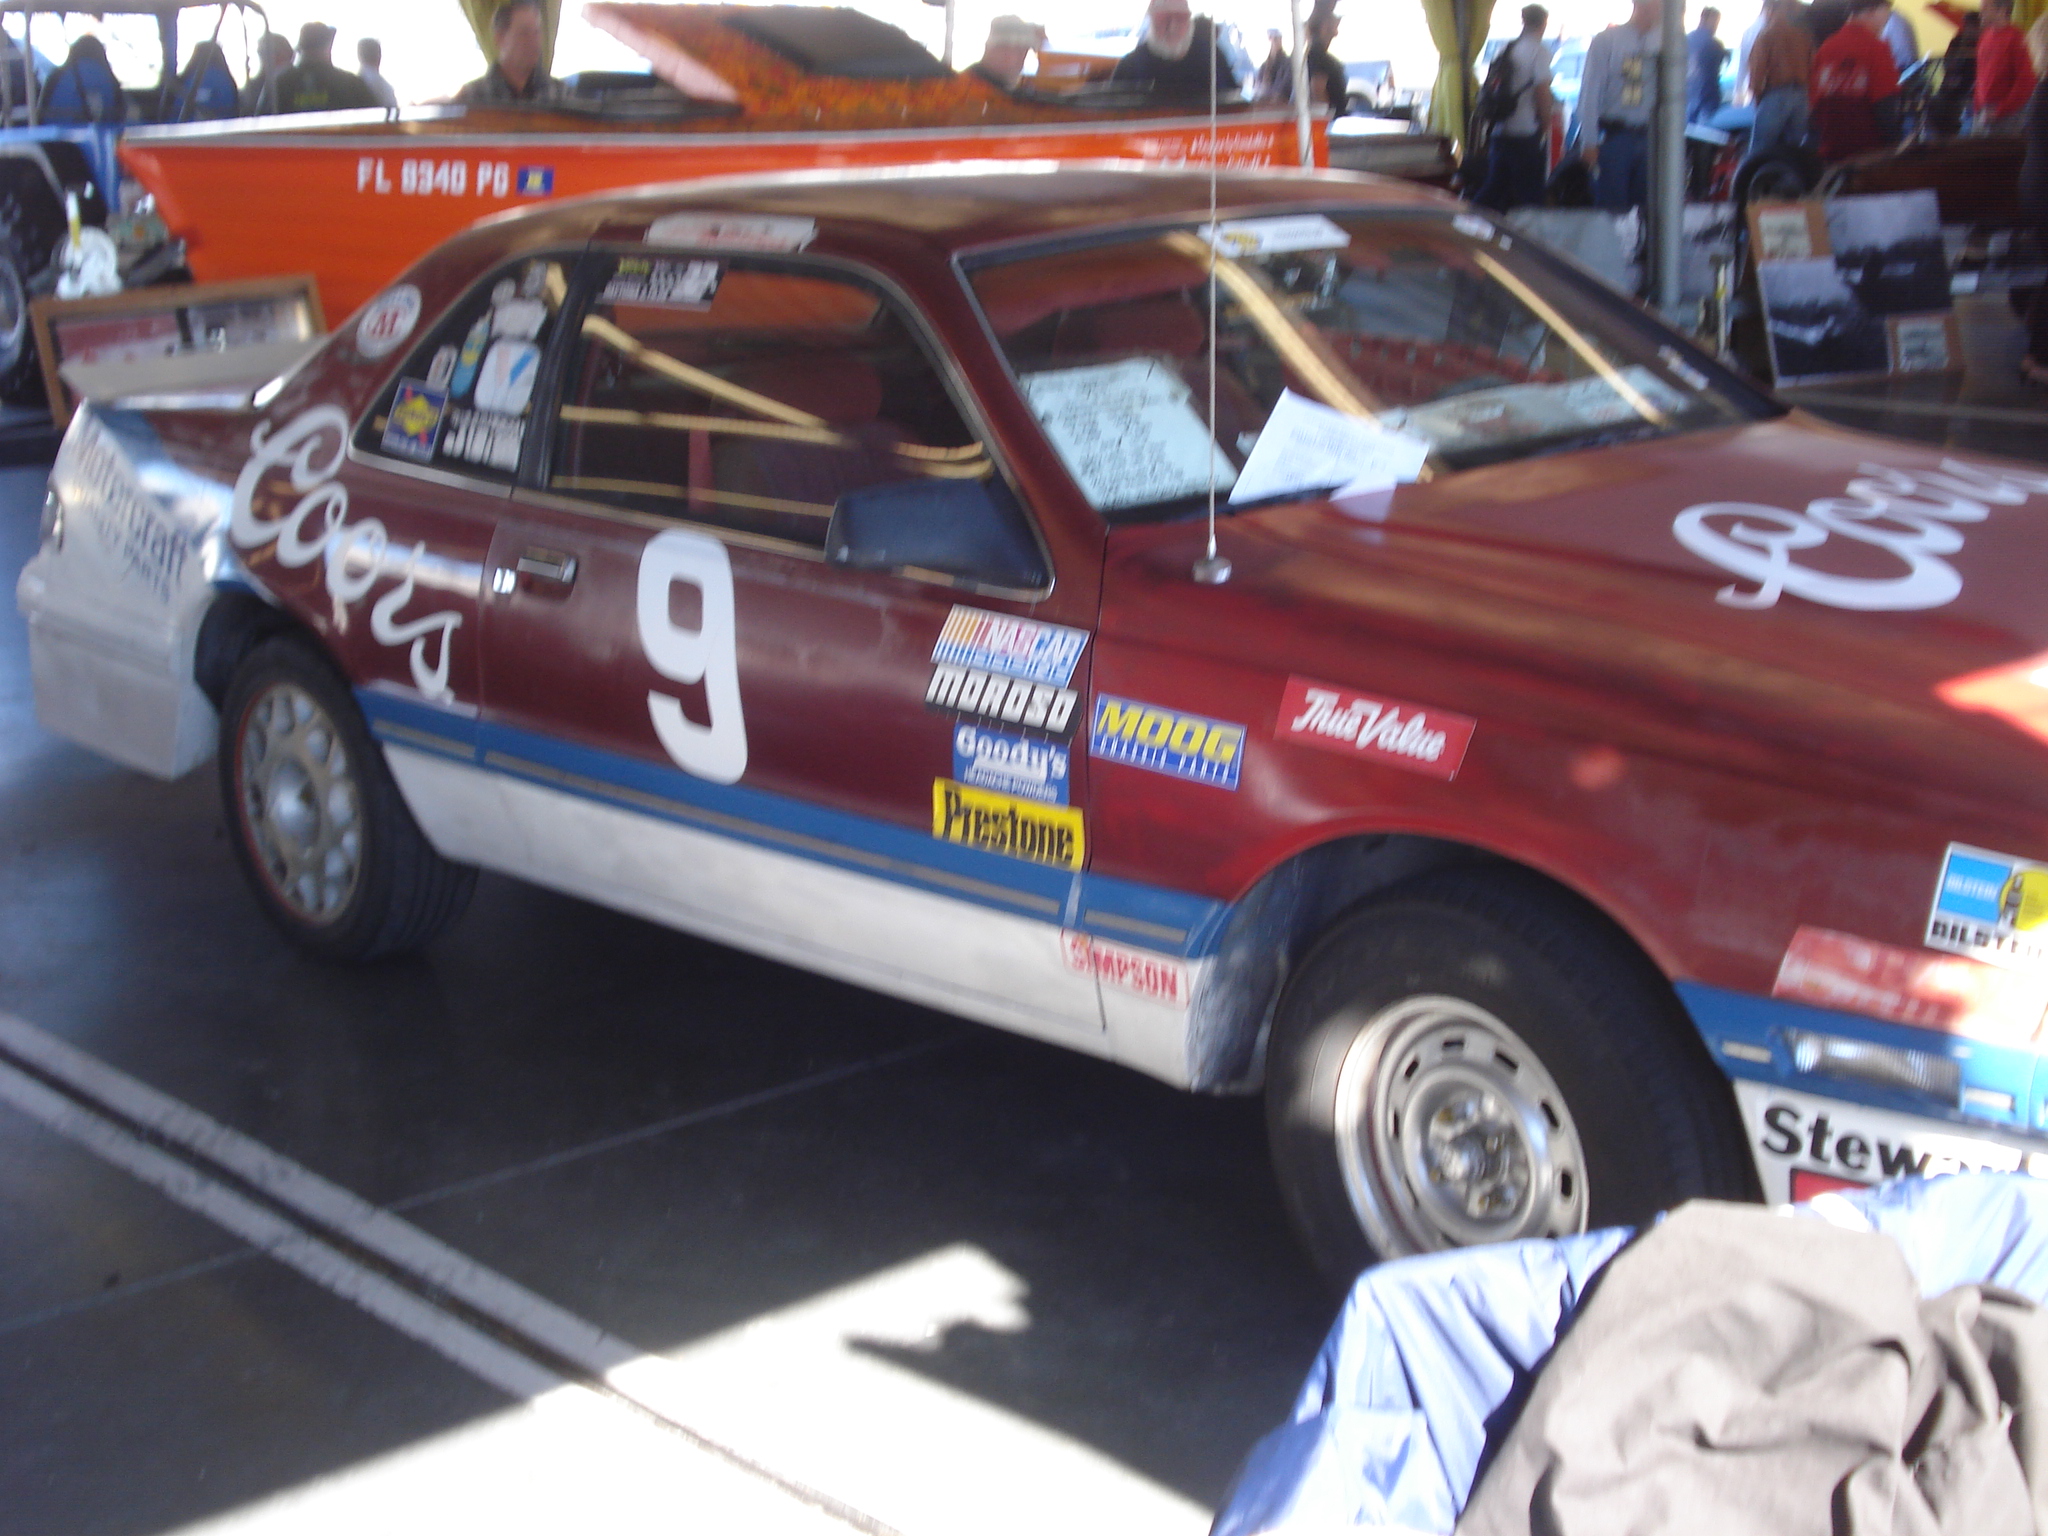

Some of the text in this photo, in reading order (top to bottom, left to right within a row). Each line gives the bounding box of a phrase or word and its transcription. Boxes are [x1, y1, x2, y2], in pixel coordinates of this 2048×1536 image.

[357, 156, 392, 194] FL
[230, 403, 463, 704] Coors
[637, 527, 748, 786] 9
[982, 614, 1088, 668] NASCAR
[926, 662, 1078, 734] MOROSO
[1096, 699, 1243, 765] MOOG
[956, 724, 1068, 781] Goody's
[945, 789, 1074, 862] Prestone
[1070, 934, 1178, 1003] SIMPSON
